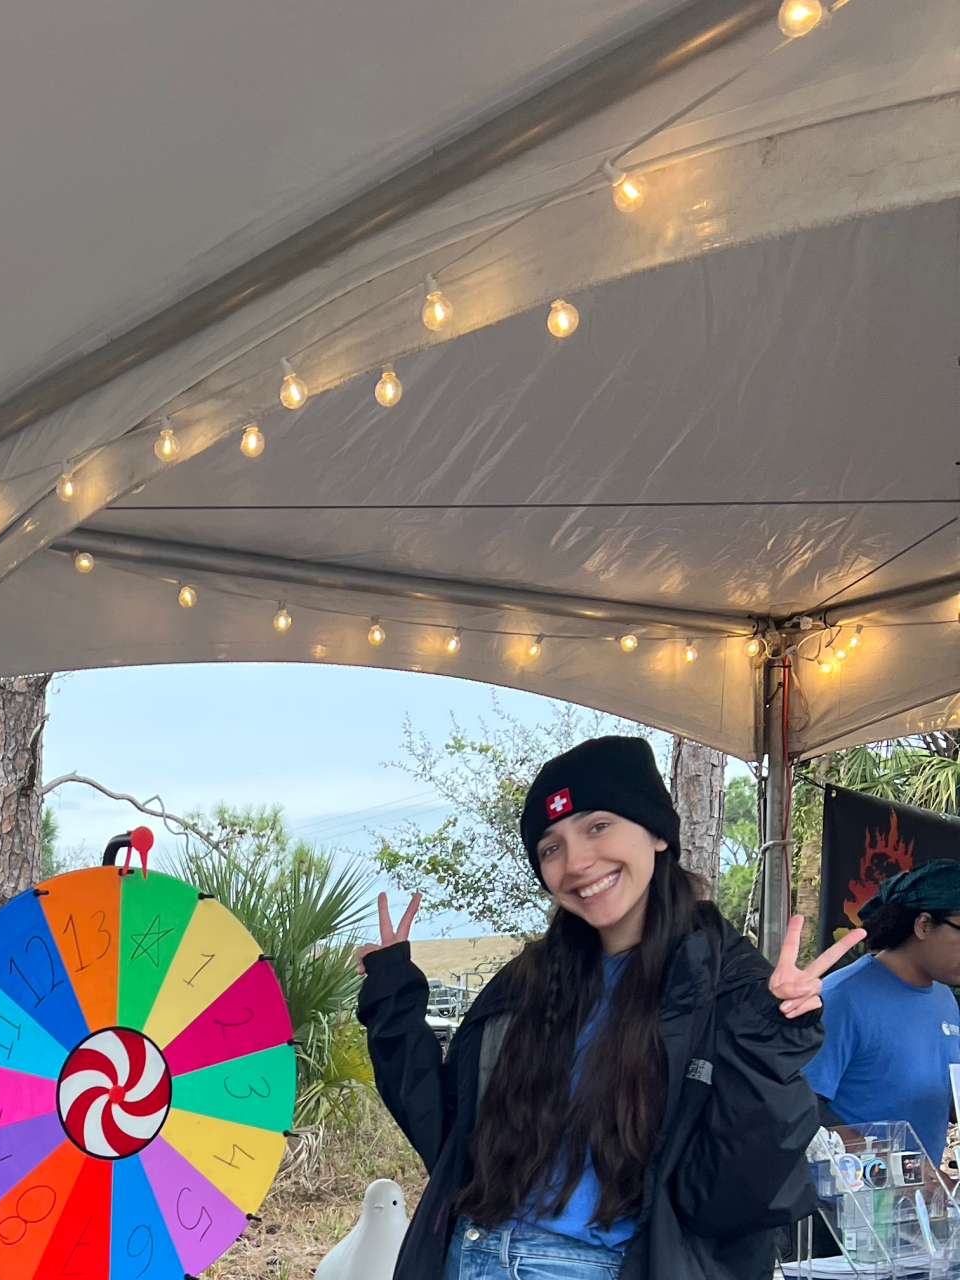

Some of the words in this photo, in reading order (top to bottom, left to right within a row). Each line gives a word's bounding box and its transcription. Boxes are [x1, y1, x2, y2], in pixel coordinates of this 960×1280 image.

[63, 910, 111, 973] 13
[9, 936, 64, 1008] 12
[182, 953, 215, 988] 1
[213, 1006, 255, 1041] 2
[224, 1076, 271, 1099] 3
[213, 1143, 255, 1169] 4
[177, 1187, 213, 1243] 5
[61, 1215, 92, 1276] 7
[126, 1222, 154, 1280] 6
